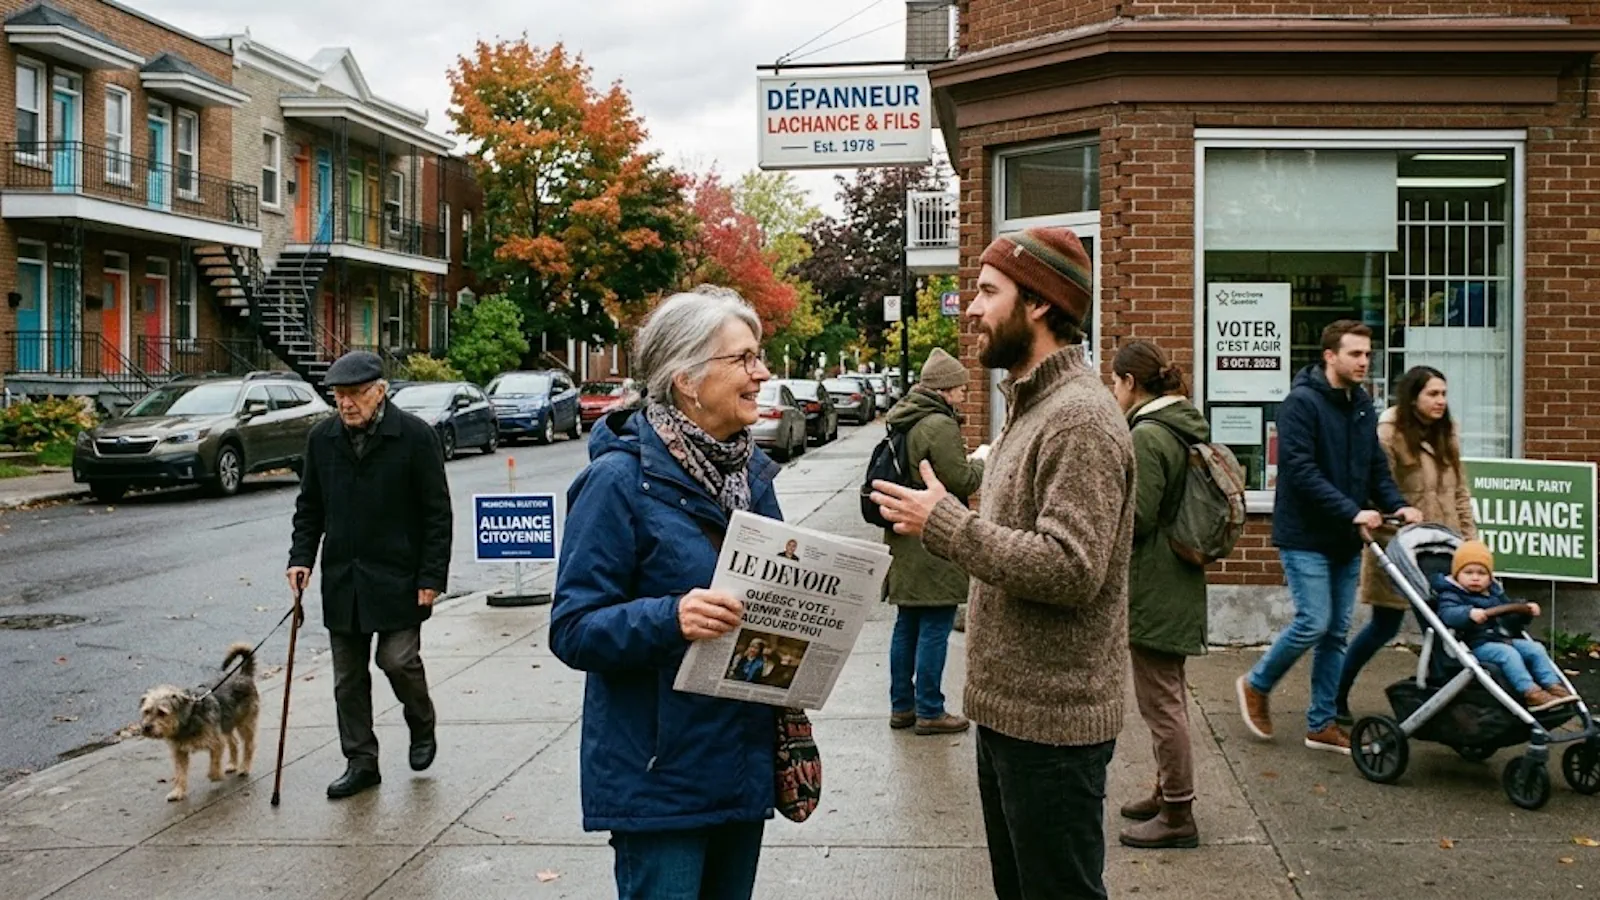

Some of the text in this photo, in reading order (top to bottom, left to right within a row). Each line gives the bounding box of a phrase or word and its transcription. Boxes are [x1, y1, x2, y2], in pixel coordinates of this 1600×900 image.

[767, 82, 920, 109] DÉPANNEUR
[768, 112, 920, 132] LACHANCE & FILS
[814, 139, 874, 153] Est. 1978
[1217, 321, 1281, 339] VOTER,
[1217, 341, 1281, 352] C'EST AGIR
[1230, 358, 1252, 369] OCT.
[1475, 477, 1572, 493] MUNICIPAL PARTY
[480, 515, 552, 530] ALLIANCE
[480, 530, 552, 543] CITOYENNE
[1478, 529, 1585, 559] TOYENNE
[728, 550, 759, 577] LE
[760, 559, 841, 596] DEVOIR
[798, 600, 829, 614] VOTE
